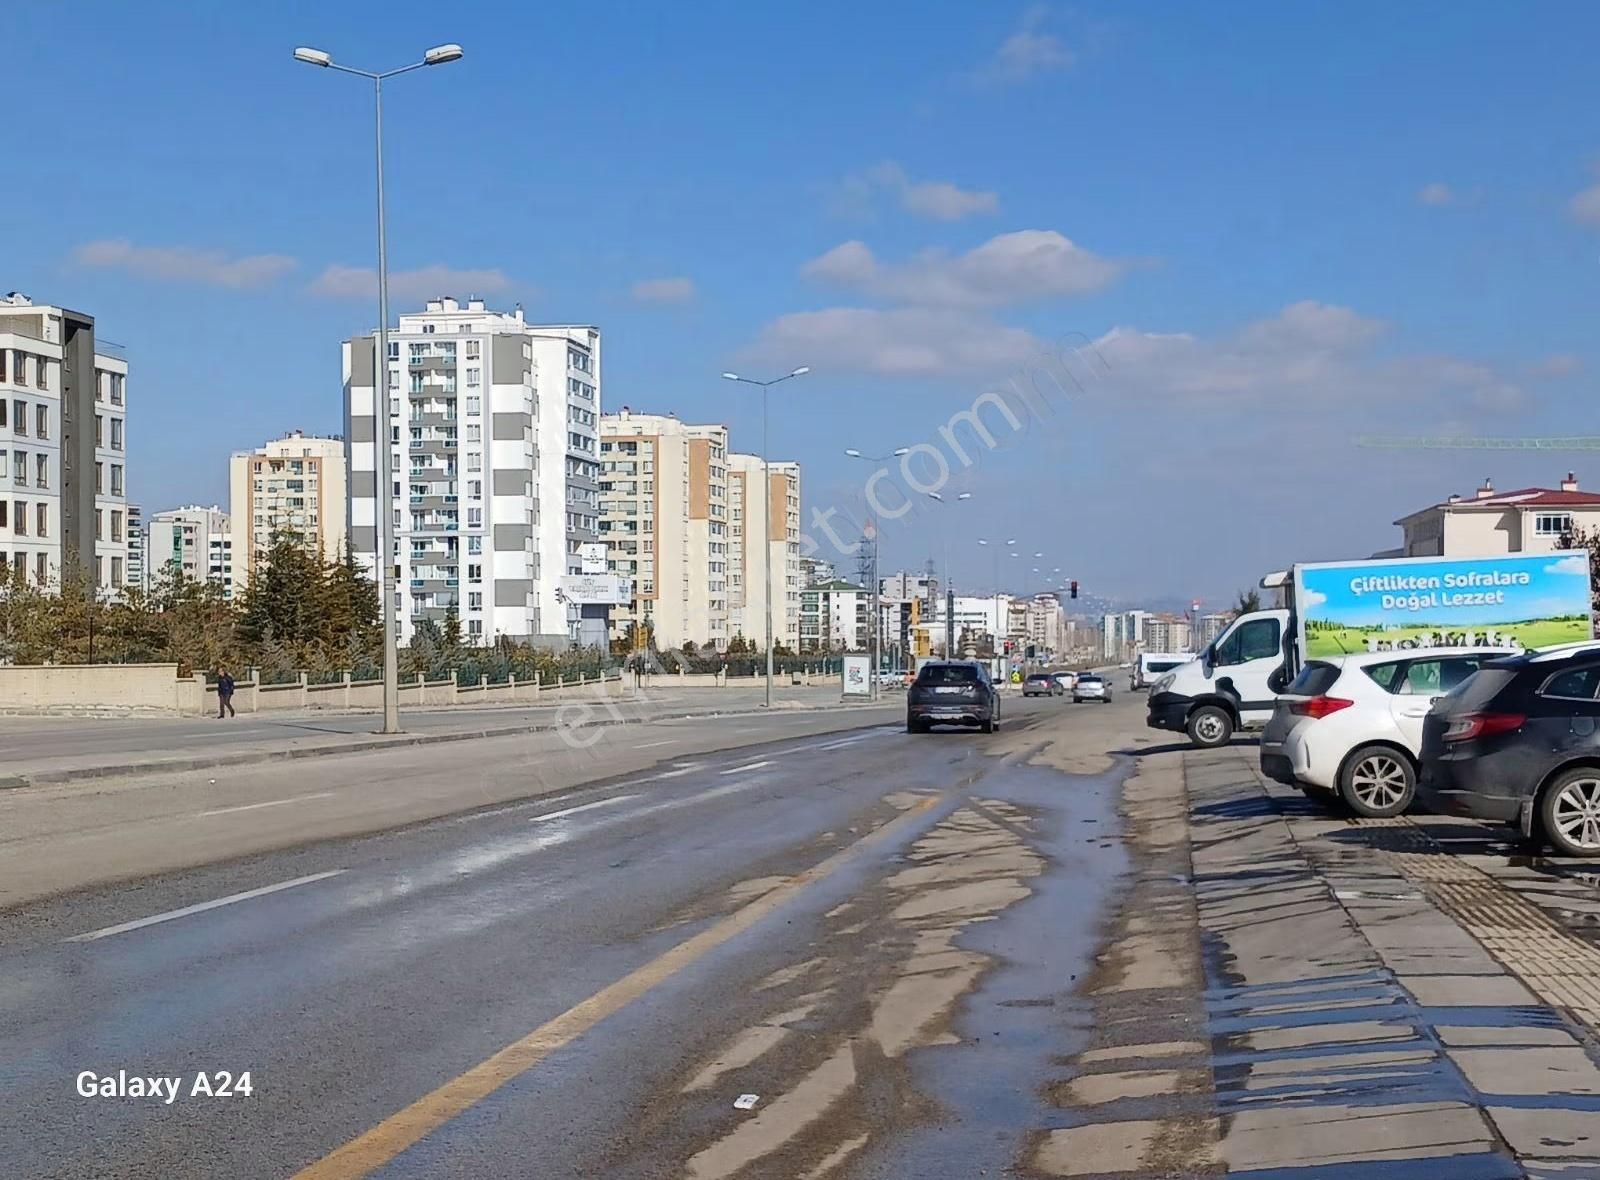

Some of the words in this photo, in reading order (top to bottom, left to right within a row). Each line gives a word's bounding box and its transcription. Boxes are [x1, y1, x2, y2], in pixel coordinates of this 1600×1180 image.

[1350, 573, 1440, 595] Çiftlikten
[1444, 571, 1530, 589] Sofralara
[1382, 591, 1437, 611] Doğal
[1442, 590, 1505, 607] Lezzet
